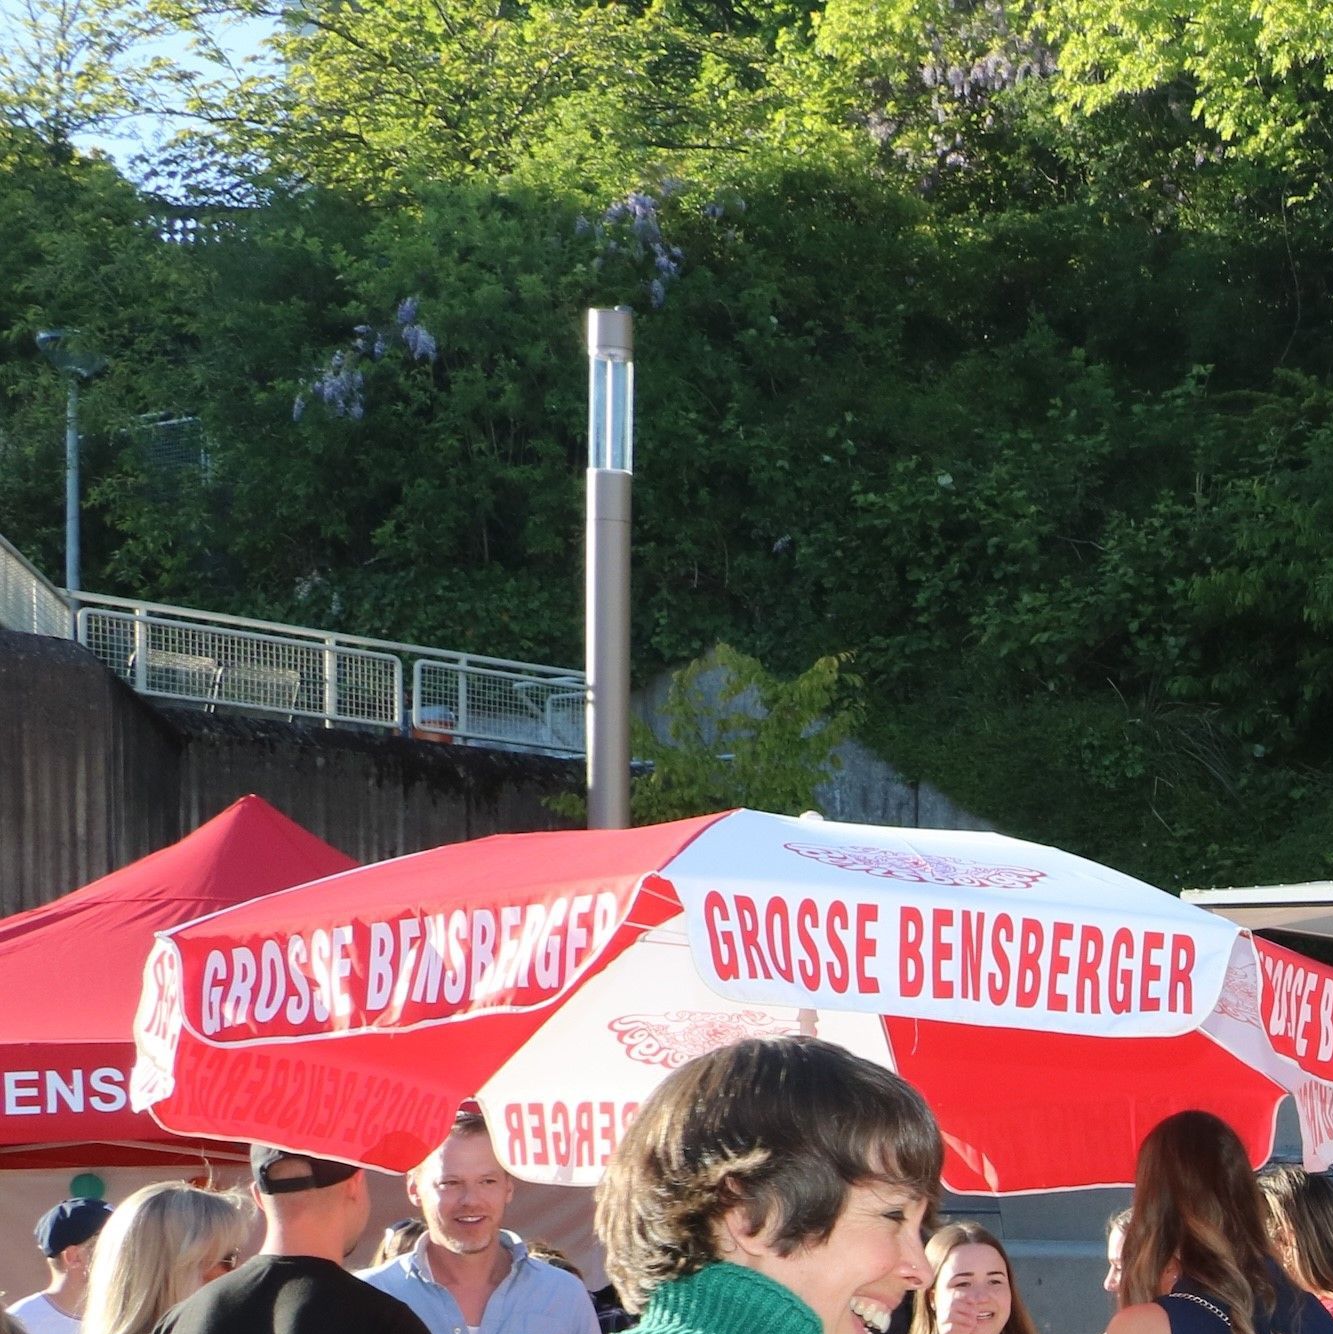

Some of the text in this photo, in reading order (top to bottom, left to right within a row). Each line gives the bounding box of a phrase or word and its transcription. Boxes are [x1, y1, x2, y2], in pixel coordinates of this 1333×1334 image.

[201, 925, 353, 1036] GROSSE
[704, 889, 880, 995] GROSSE
[899, 905, 1196, 1015] BENSBERGER
